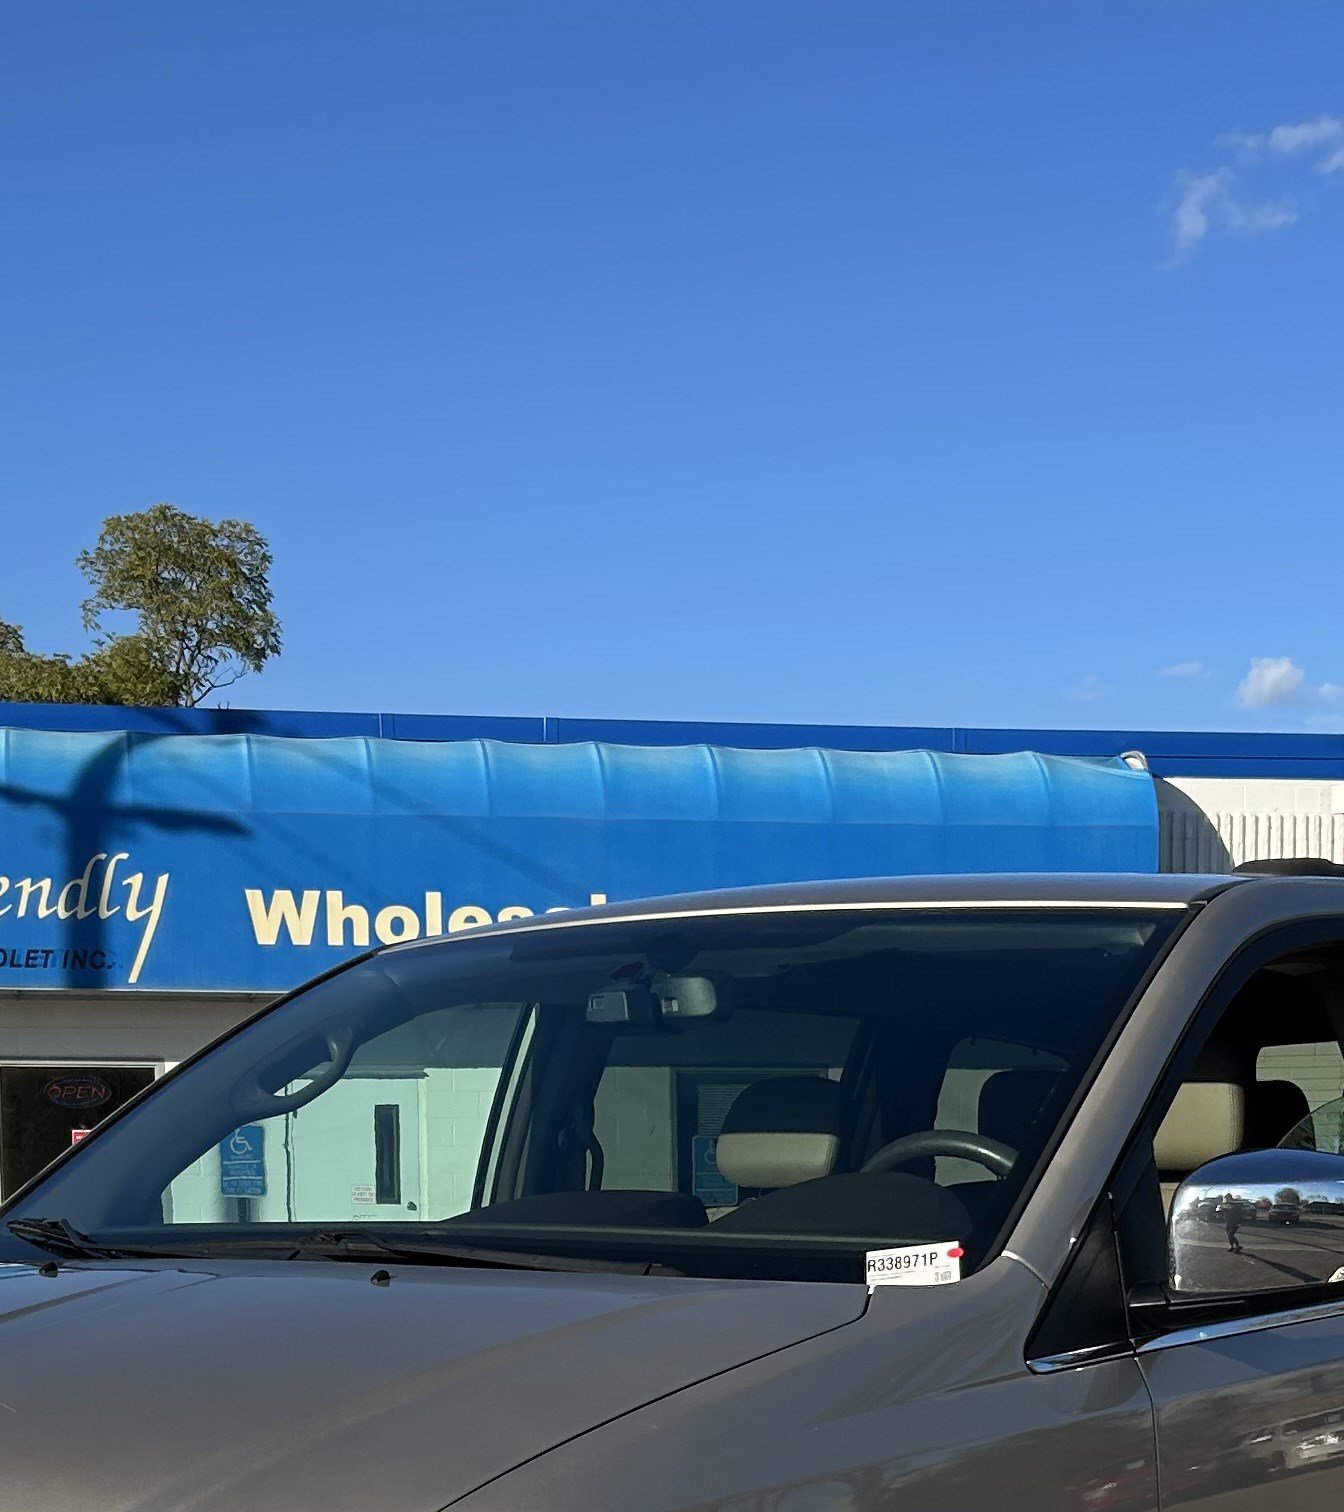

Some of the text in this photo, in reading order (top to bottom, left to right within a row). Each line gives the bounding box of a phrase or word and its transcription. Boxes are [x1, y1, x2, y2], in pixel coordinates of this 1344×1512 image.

[244, 889, 607, 946] Whole
[48, 1085, 106, 1099] OPEN
[867, 1252, 938, 1273] R338971P
